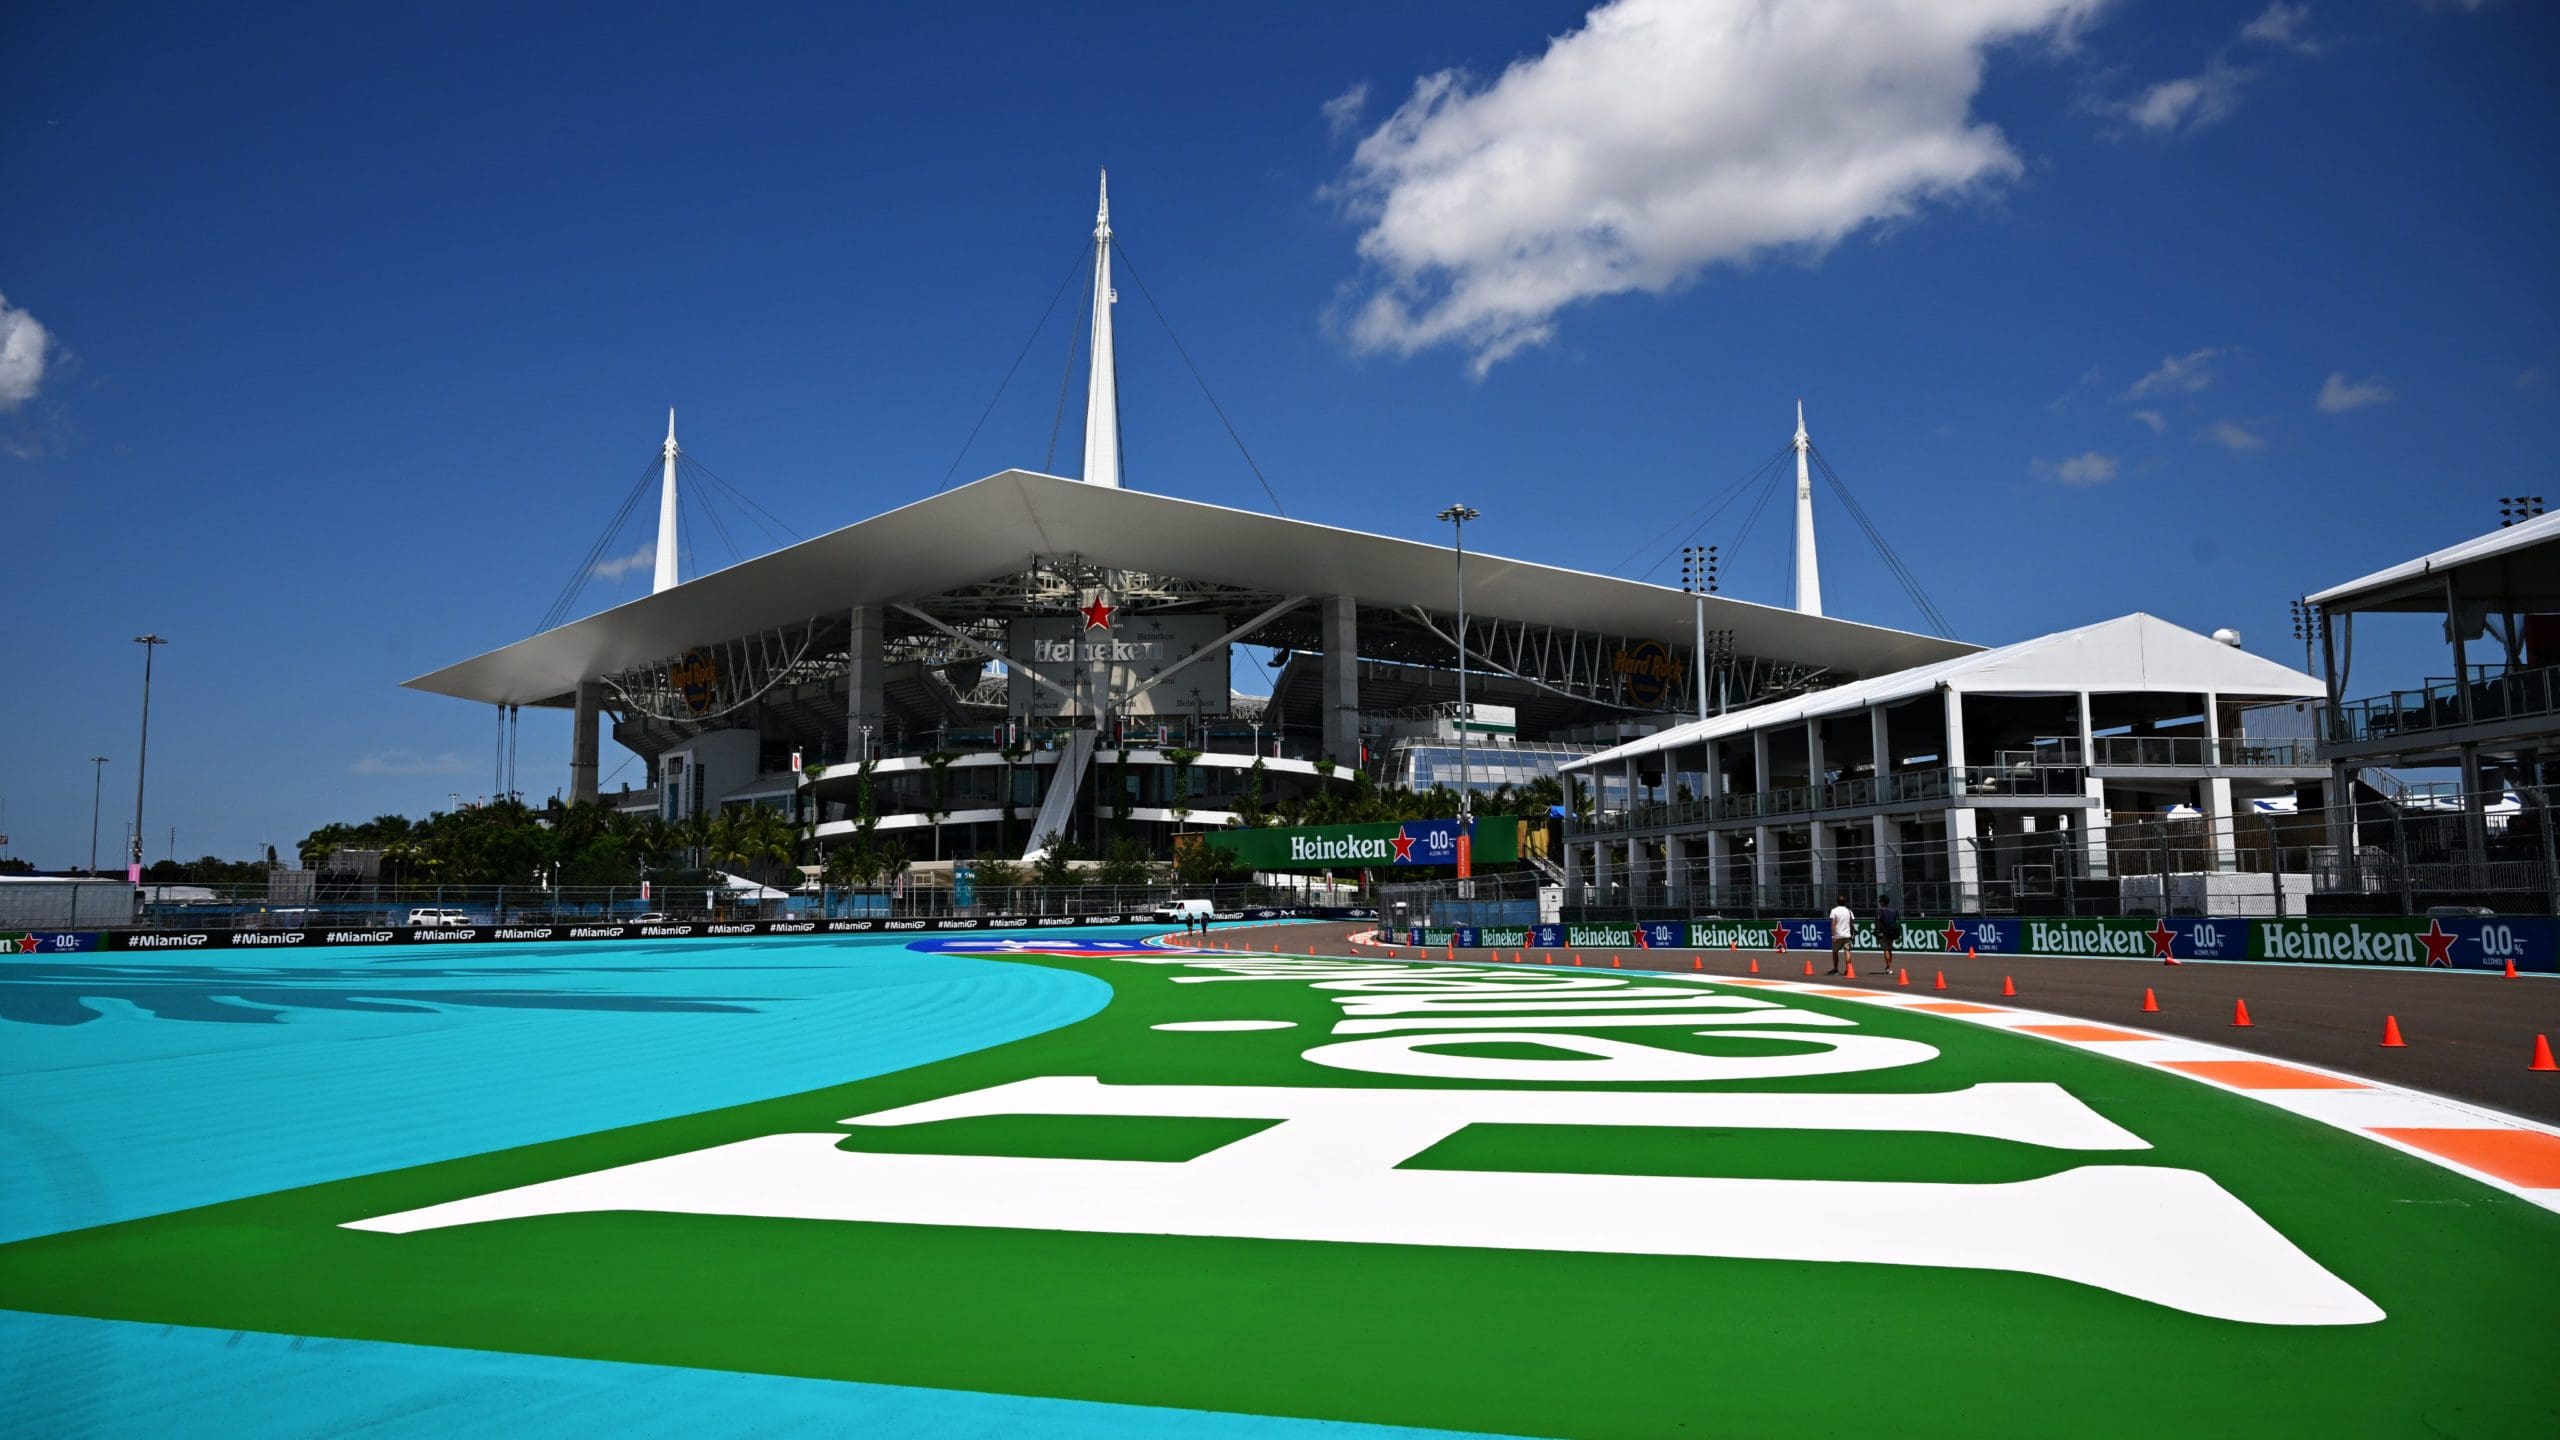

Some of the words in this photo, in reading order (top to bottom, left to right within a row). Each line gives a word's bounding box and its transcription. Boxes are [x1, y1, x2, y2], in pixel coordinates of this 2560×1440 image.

[1034, 638, 1163, 662] Heineken
[1615, 649, 1650, 675] Hard
[1651, 656, 1682, 682] Rock
[1291, 834, 1387, 860] Heineken
[1130, 915, 1155, 923] #Miam
[641, 926, 692, 935] #MiamiGP
[707, 924, 755, 933] #MiamiGP
[770, 923, 815, 932] #MiamiGP
[829, 922, 872, 930] #MiamiGP
[885, 921, 926, 929] #MiamiGP
[326, 931, 393, 942] #MiamiGP
[413, 930, 475, 940] #MiamiGP
[494, 929, 552, 938] #MiamiGP
[570, 928, 624, 937] #MiamiGP
[1482, 928, 1524, 946] Heineken
[1569, 926, 1631, 946] Heineken
[1691, 925, 1770, 946] Heineken
[1852, 923, 1939, 949] eiken
[129, 934, 207, 946] #MiamiGP
[232, 933, 304, 944] #MiamiGP
[2030, 923, 2146, 954] Heineken
[2261, 922, 2416, 962] Heineken
[337, 957, 2387, 1325] Heineken
